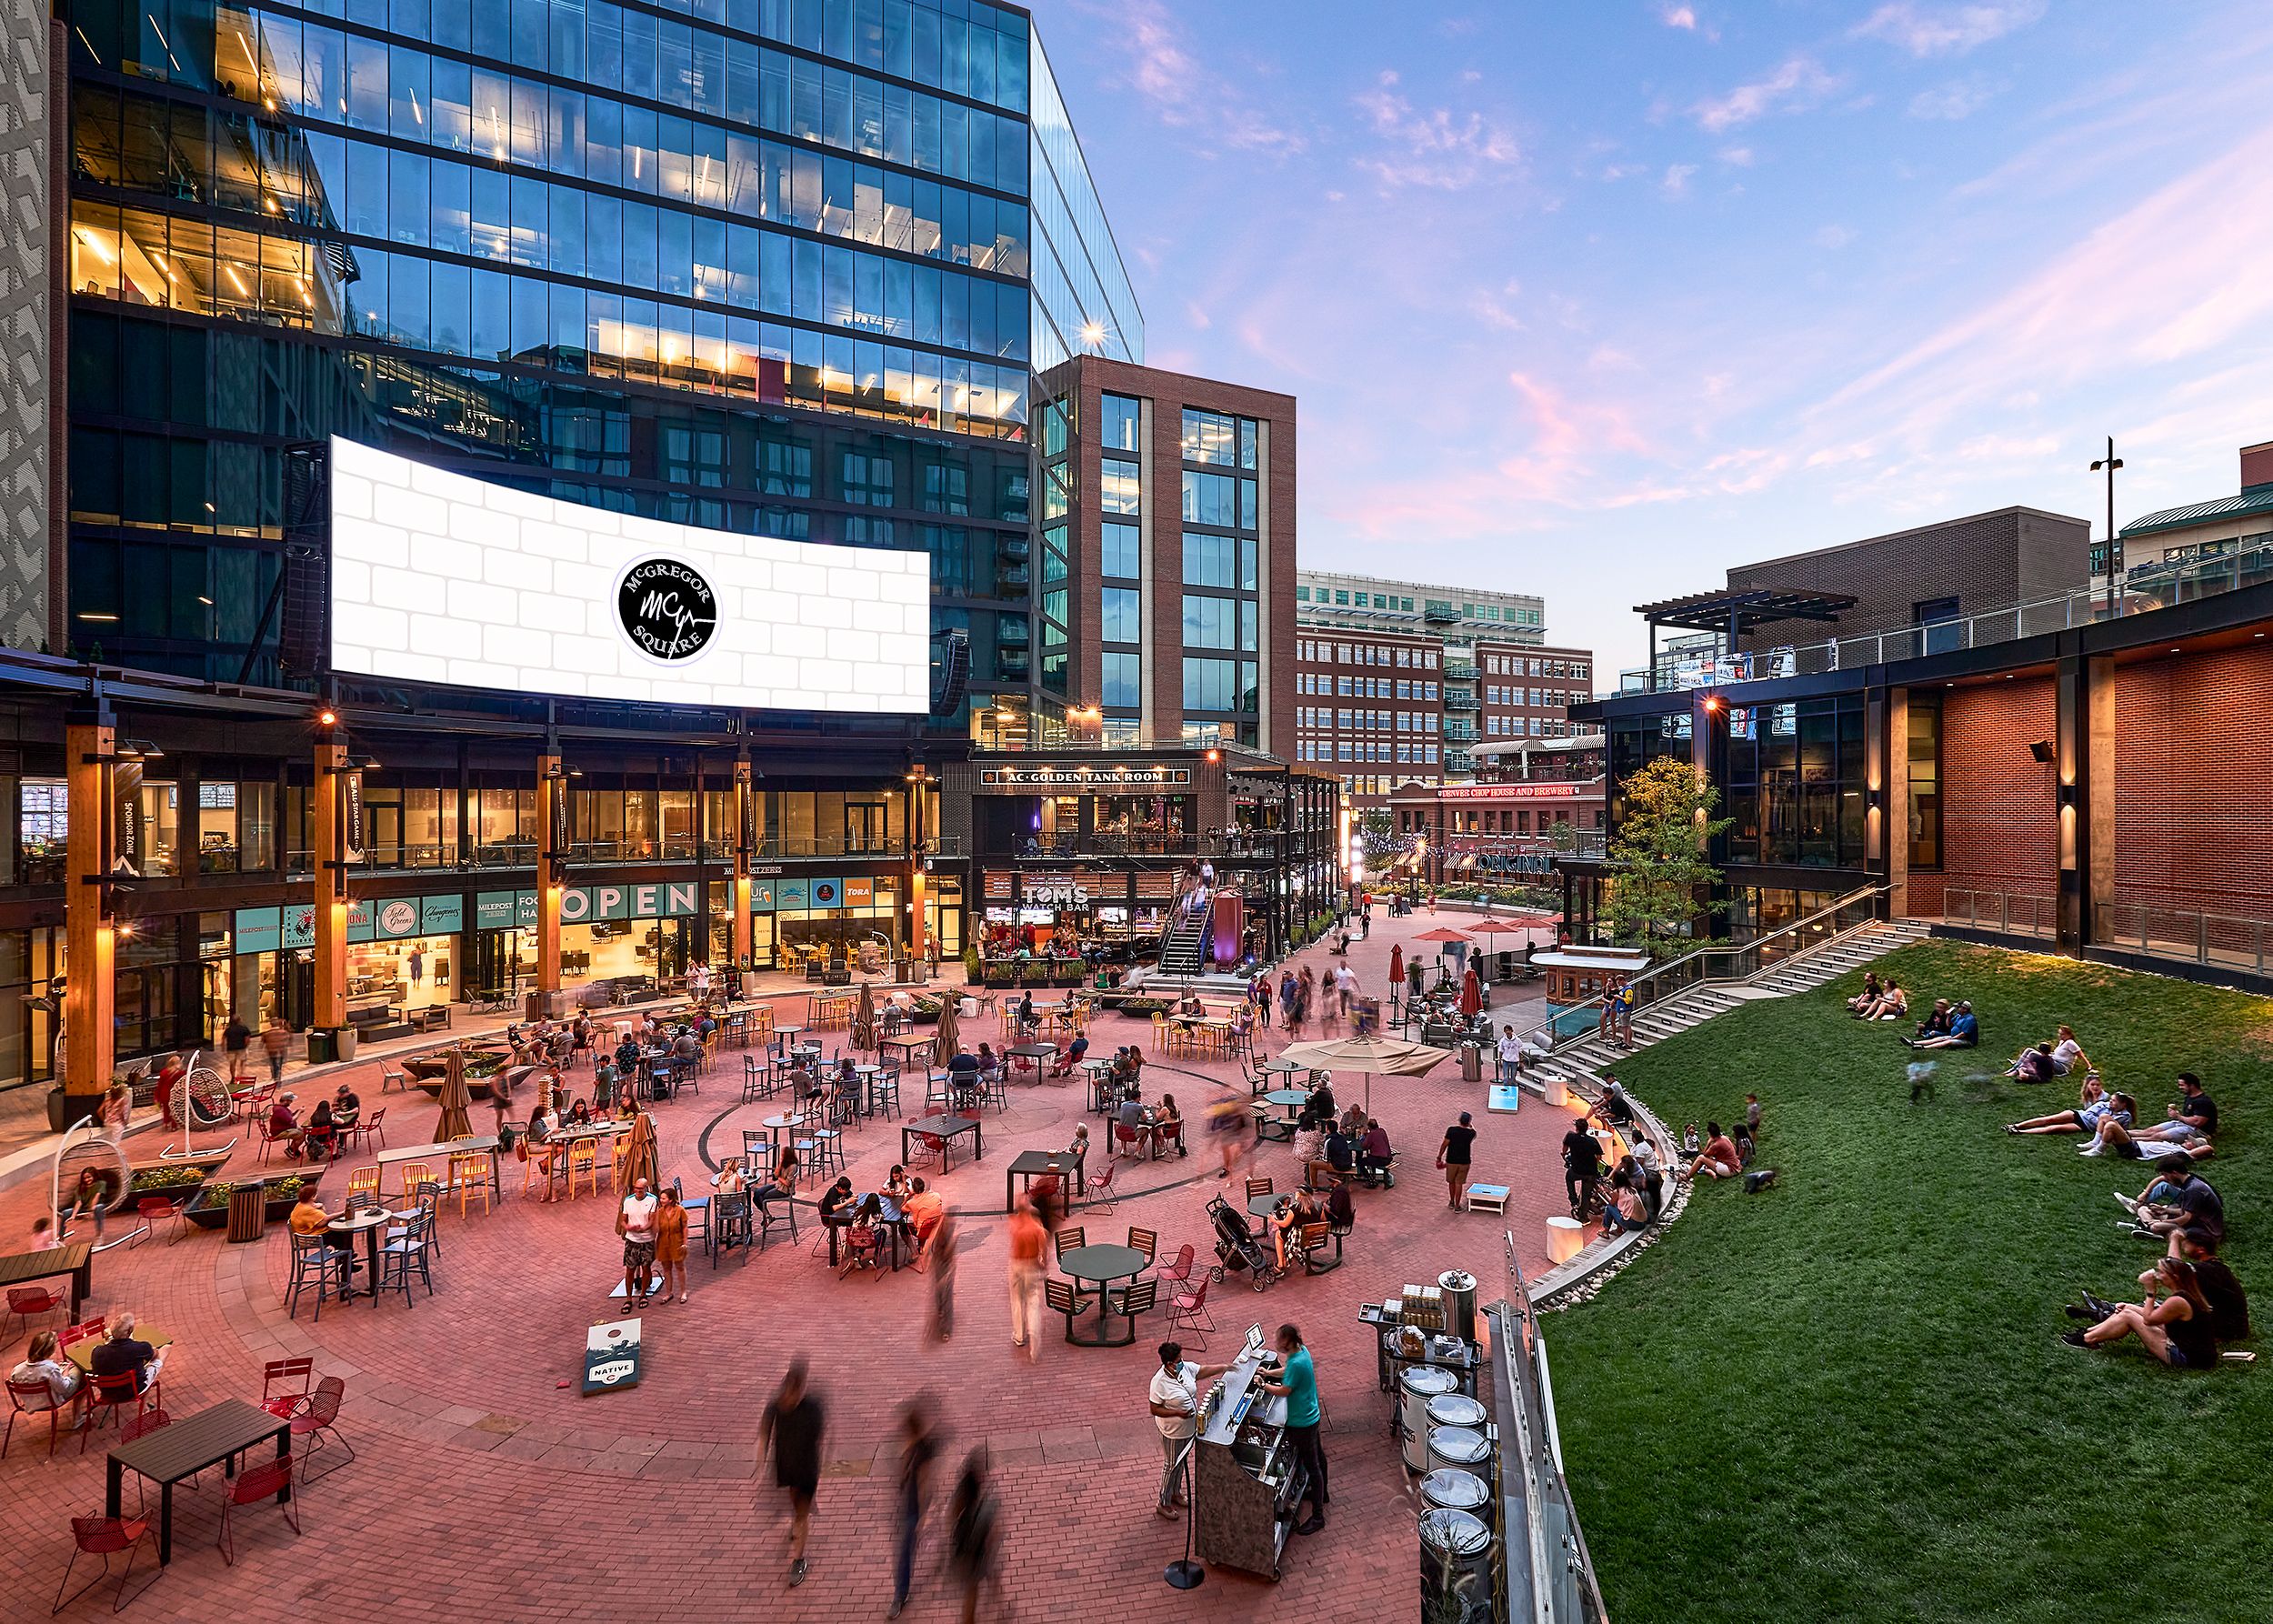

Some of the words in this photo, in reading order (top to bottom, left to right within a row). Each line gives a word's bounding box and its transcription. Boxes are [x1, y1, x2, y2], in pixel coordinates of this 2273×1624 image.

[633, 625, 703, 654] SQUARE
[1031, 773, 1082, 782] GOLDEN
[1086, 772, 1121, 782] TANK
[1124, 772, 1164, 782] ROOM
[1442, 788, 1470, 798] DENVER
[1470, 787, 1491, 797] CHOP
[1490, 787, 1515, 797] HOUSE
[1516, 787, 1534, 797] AND
[1534, 786, 1575, 796] BREWERY
[125, 802, 134, 835] SPONSOR
[125, 835, 135, 855] ZONE
[1477, 853, 1555, 875] ORIGINAL
[846, 888, 870, 897] TORA
[478, 902, 514, 911] MILEPOST
[561, 884, 695, 919] OPEN
[1022, 903, 1062, 912] WATCH
[1066, 903, 1090, 912] BAR
[390, 917, 413, 929] Greens
[595, 1365, 630, 1376] NATIVE
